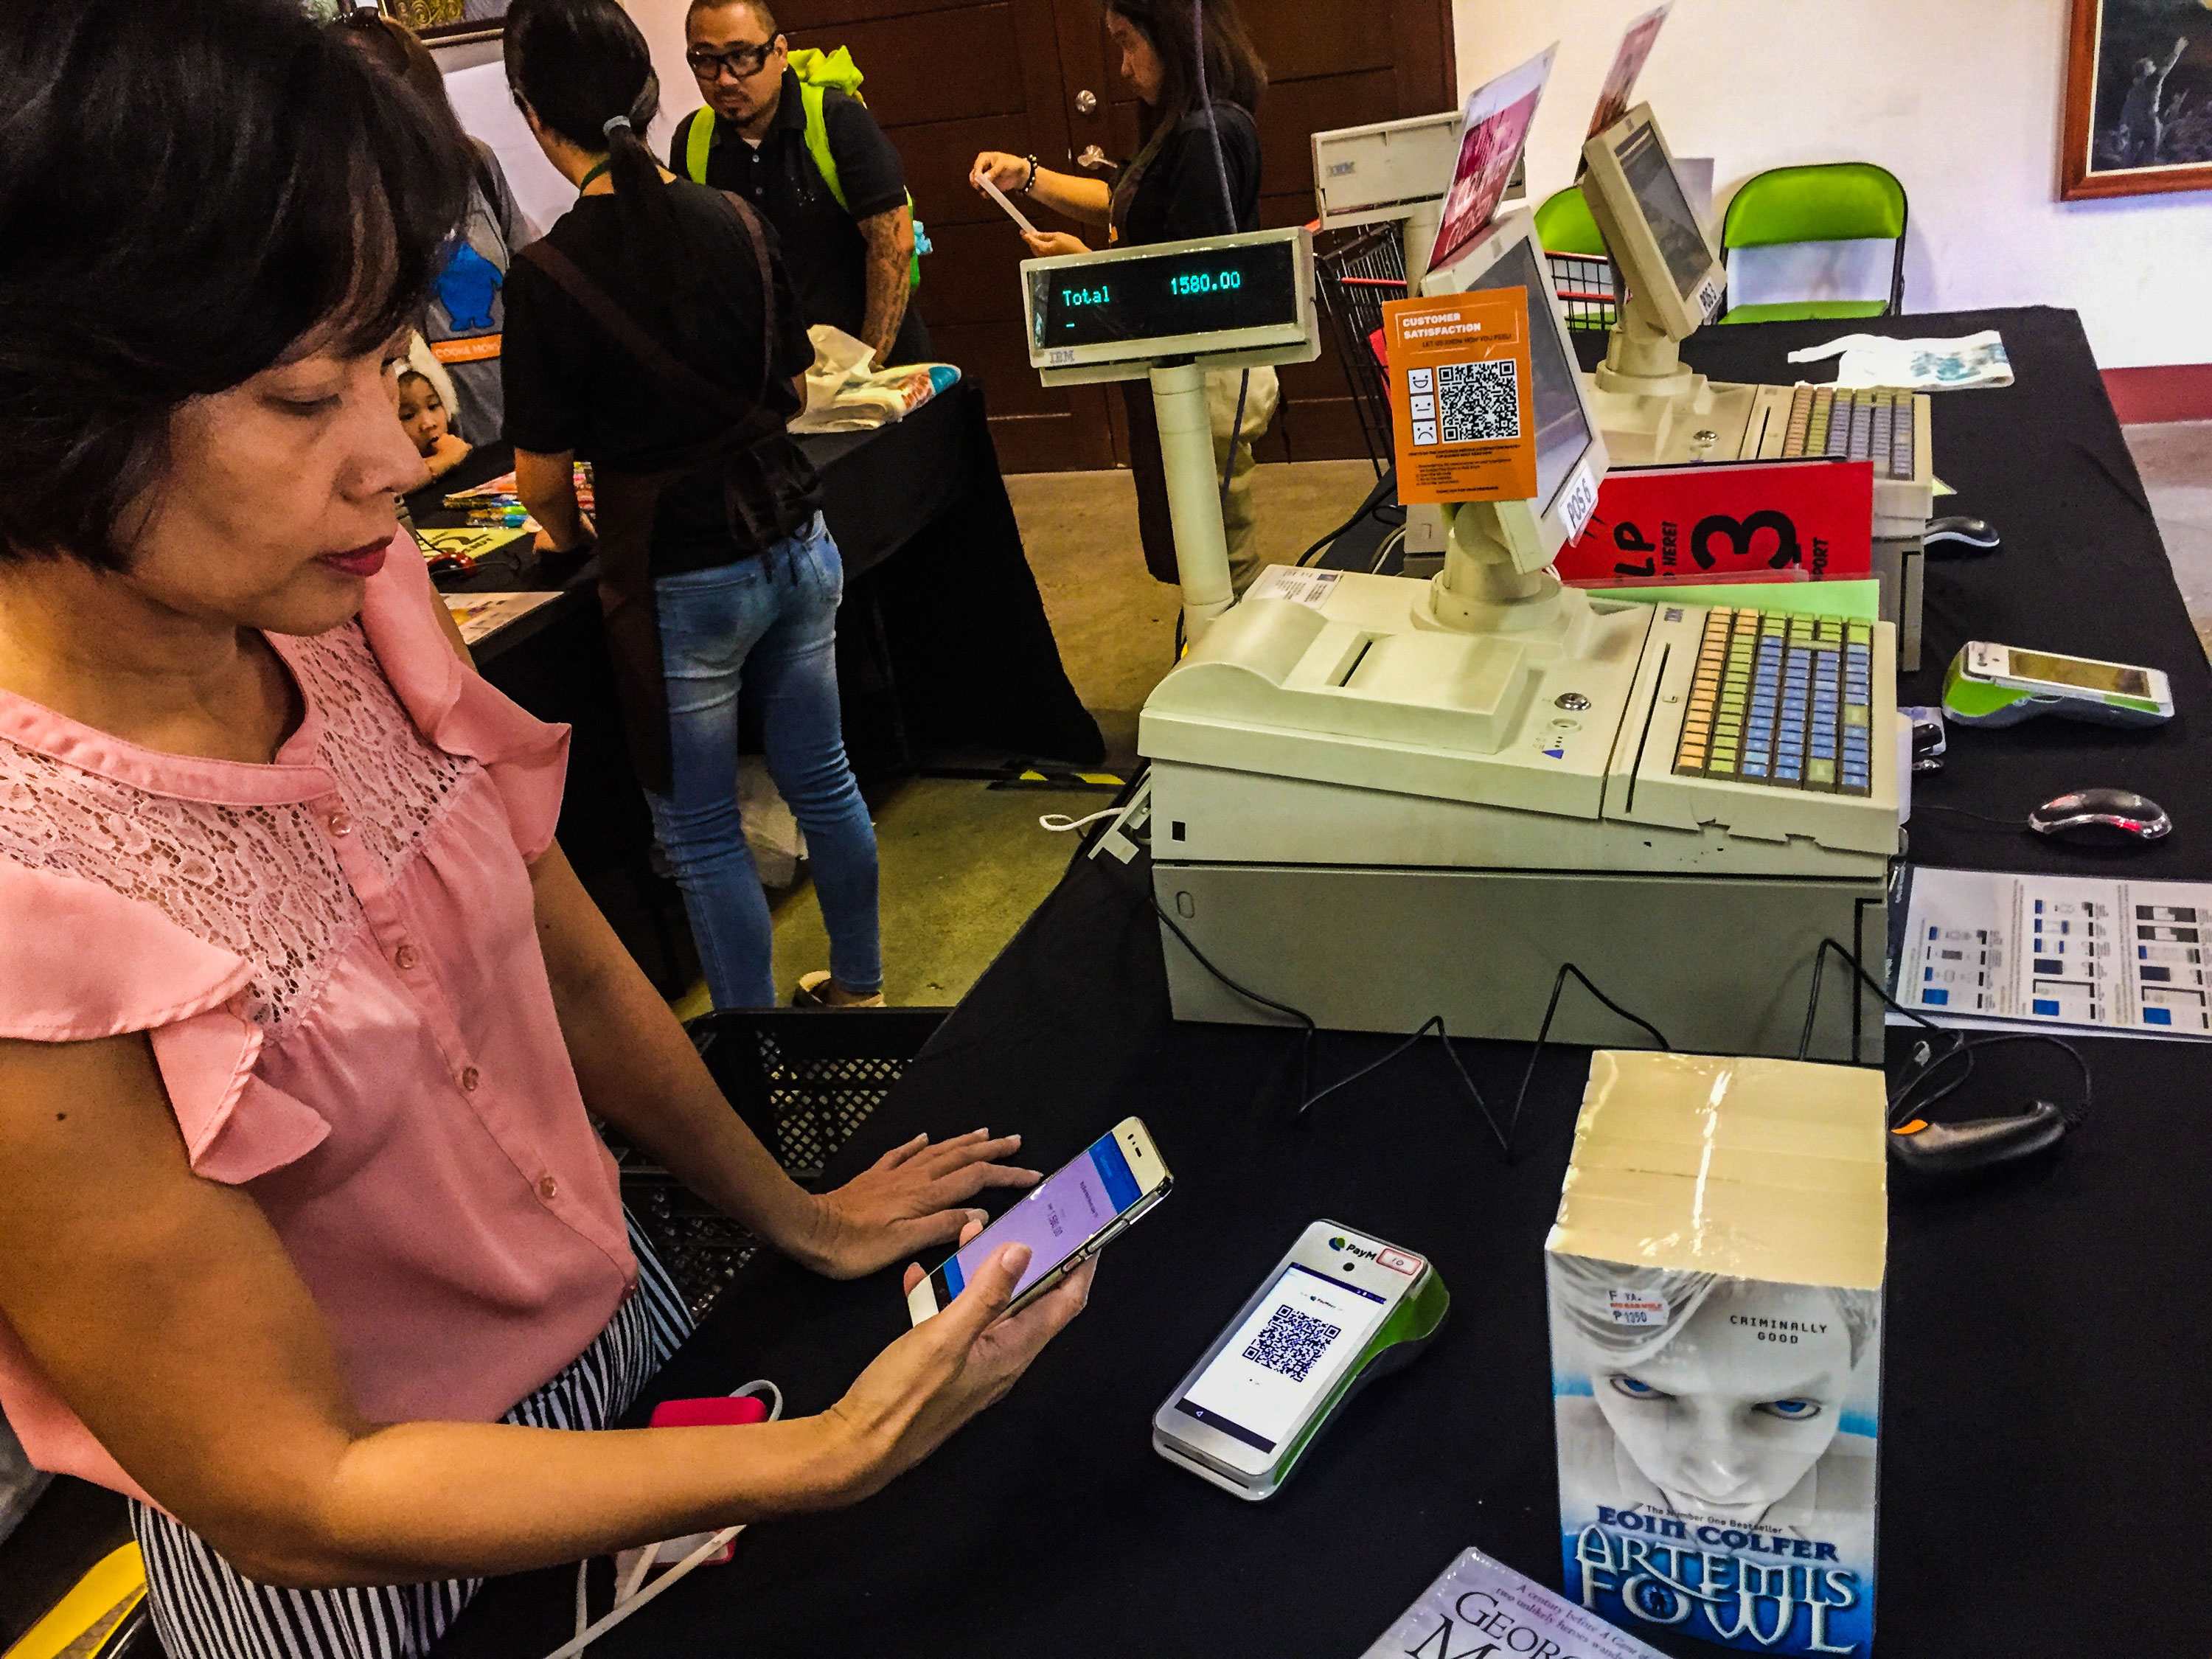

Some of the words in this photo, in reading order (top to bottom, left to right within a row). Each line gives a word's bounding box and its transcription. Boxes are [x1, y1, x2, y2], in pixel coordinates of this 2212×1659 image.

[1062, 285, 1110, 307] Total
[1171, 271, 1241, 295] 1580.00
[1402, 313, 1461, 327] CUSTOMER
[1404, 323, 1481, 340] SATISFACTION
[1049, 349, 1075, 364] IBM
[1566, 487, 1587, 529] POS
[1582, 478, 1592, 504] 6
[1691, 509, 1797, 570] 3
[1609, 1290, 1618, 1301] F
[1730, 1314, 1828, 1334] CRIMINALLY
[1757, 1332, 1799, 1344] GOOD
[1646, 1505, 1665, 1515] The
[1666, 1509, 1705, 1523] Number
[1707, 1515, 1727, 1526] One
[1730, 1519, 1783, 1534] Bestseller
[1697, 1526, 1840, 1562] COLFER
[1576, 1523, 1858, 1609] ARTEMIS
[1455, 1591, 1584, 1659] GEOR
[1495, 1588, 1514, 1601] two
[1516, 1597, 1554, 1625] unlikely
[1557, 1620, 1588, 1643] heroes
[1516, 1584, 1526, 1594] A
[1528, 1588, 1562, 1615] century
[1565, 1610, 1598, 1632] before
[1581, 1559, 1860, 1655] FOWL
